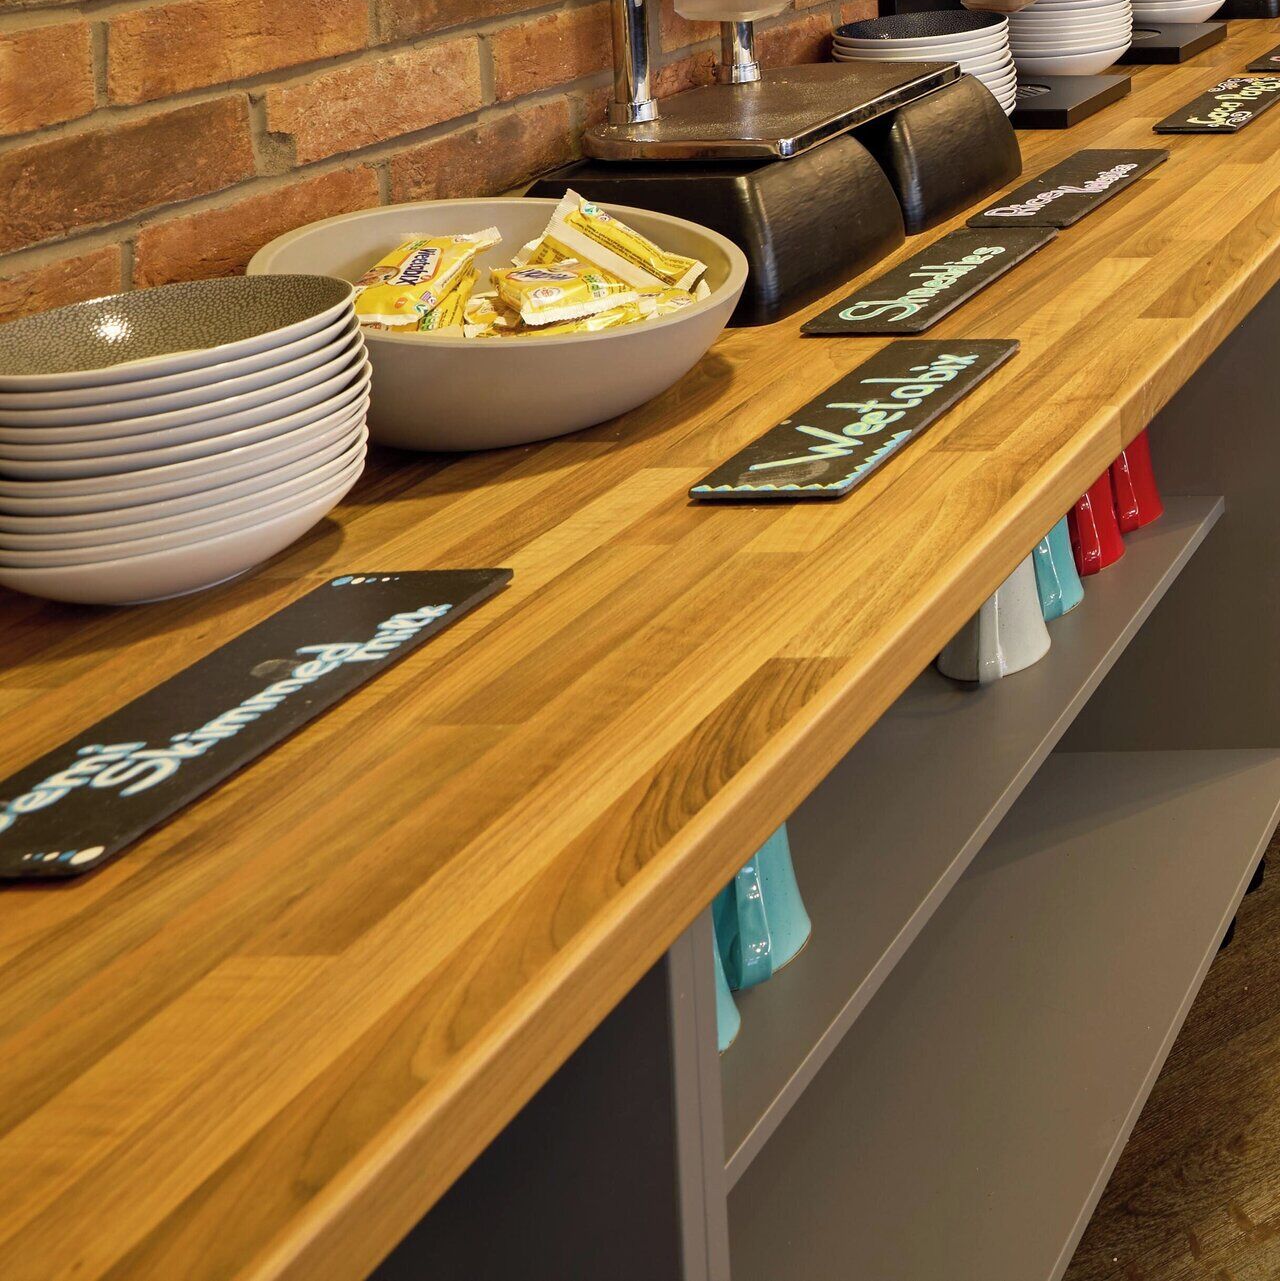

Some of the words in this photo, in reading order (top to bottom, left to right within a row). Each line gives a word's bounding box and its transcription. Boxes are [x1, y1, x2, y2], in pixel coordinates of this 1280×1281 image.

[1186, 101, 1245, 126] Coco
[983, 189, 1066, 217] Rice
[395, 248, 438, 286] Weetabix
[838, 245, 1007, 322] Shreddies
[749, 352, 981, 472] Weetabix
[342, 603, 453, 663] milk
[88, 641, 367, 798] Skimmed
